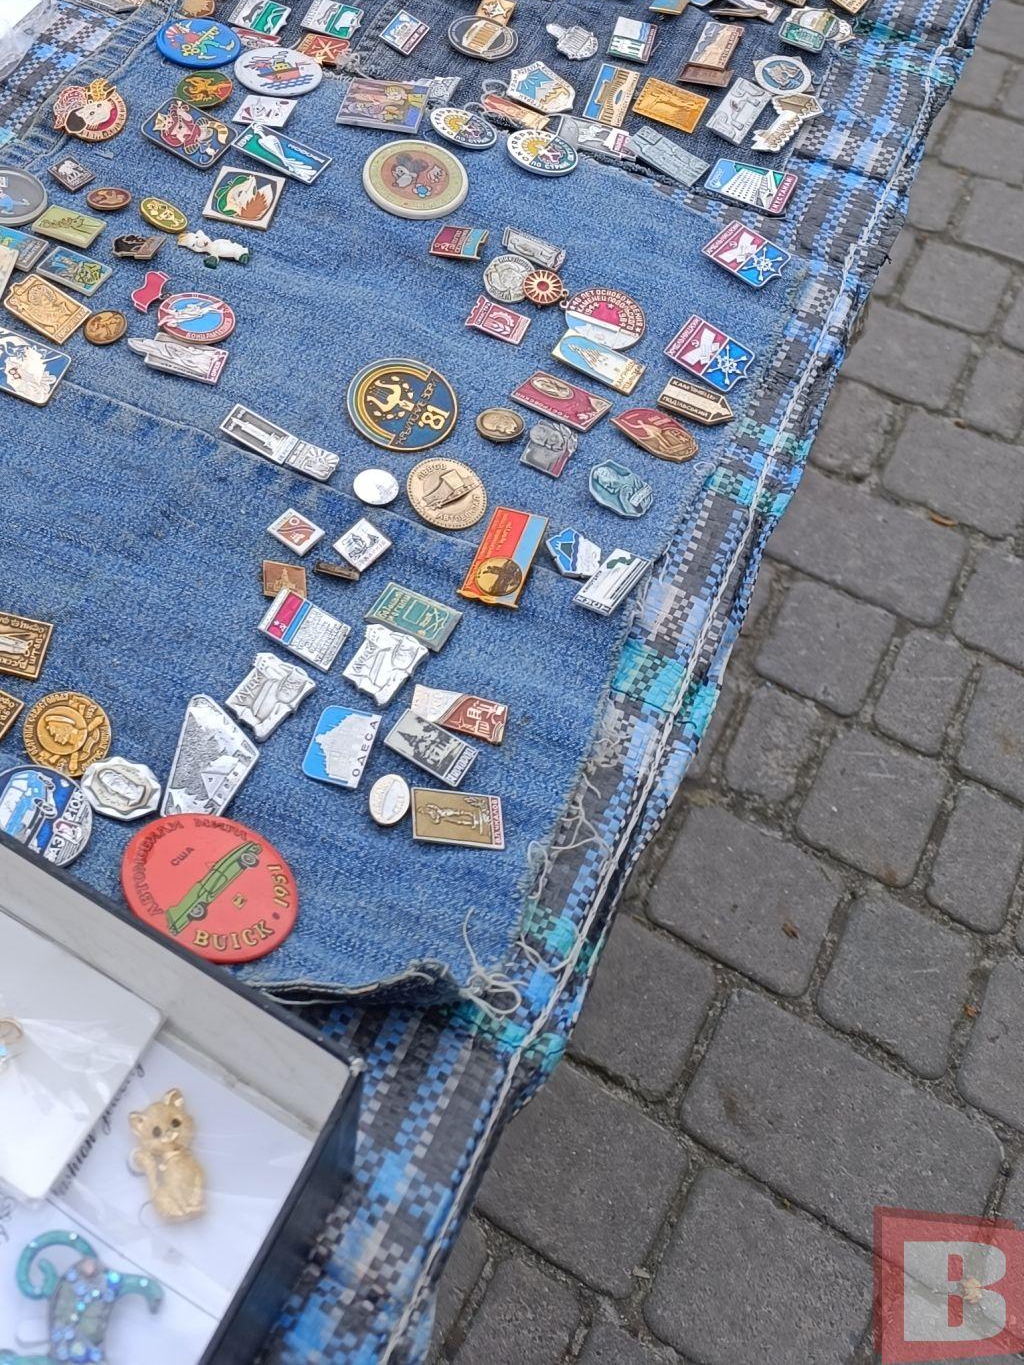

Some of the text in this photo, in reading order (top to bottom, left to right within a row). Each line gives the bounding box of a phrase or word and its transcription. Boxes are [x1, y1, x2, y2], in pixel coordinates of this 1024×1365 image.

[351, 719, 380, 778] ОДЕСА
[170, 846, 196, 867] США
[193, 863, 291, 951] BUICK 1951
